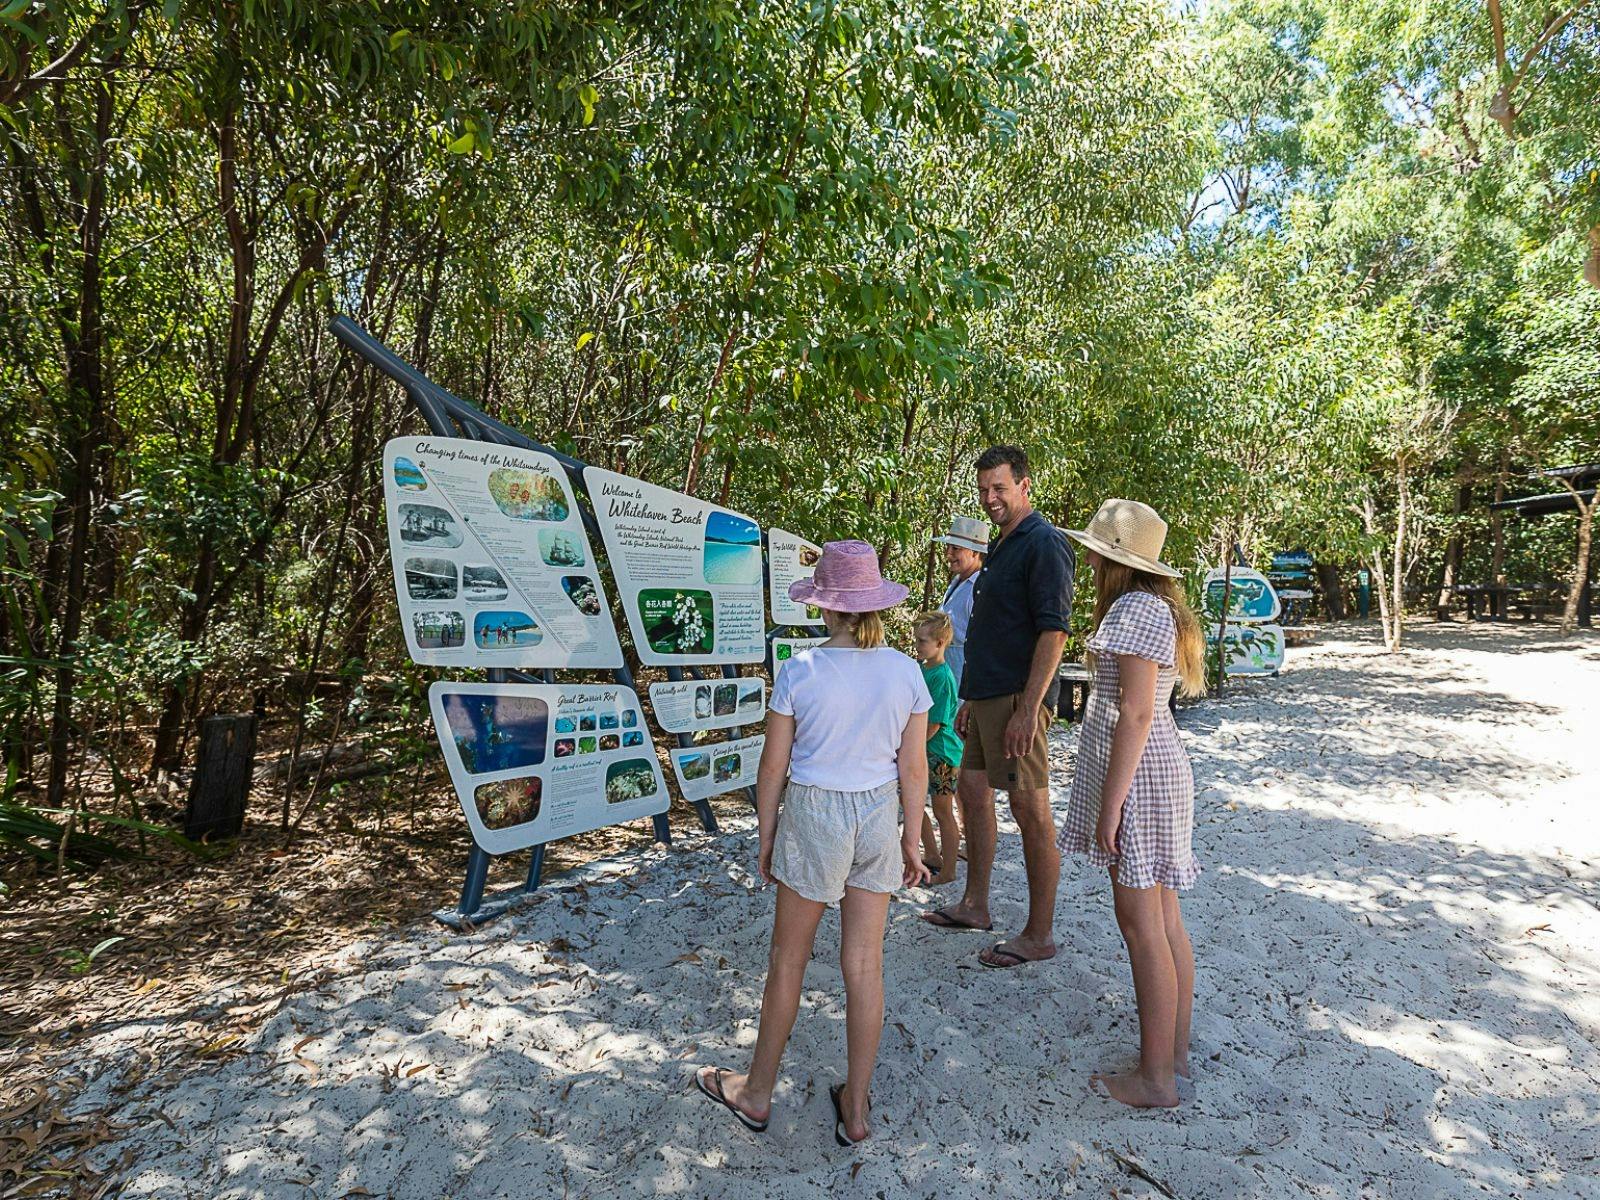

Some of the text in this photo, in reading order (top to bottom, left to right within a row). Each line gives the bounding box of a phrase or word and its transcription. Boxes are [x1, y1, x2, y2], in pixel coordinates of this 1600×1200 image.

[416, 442, 550, 473] Changing times of the Whitsundays
[602, 482, 642, 498] Welcome to
[609, 499, 702, 524] Whitehaven Beach
[655, 684, 688, 697] Naturally wild
[557, 691, 617, 707] Great Barrier Reef
[713, 748, 727, 756] Caring
